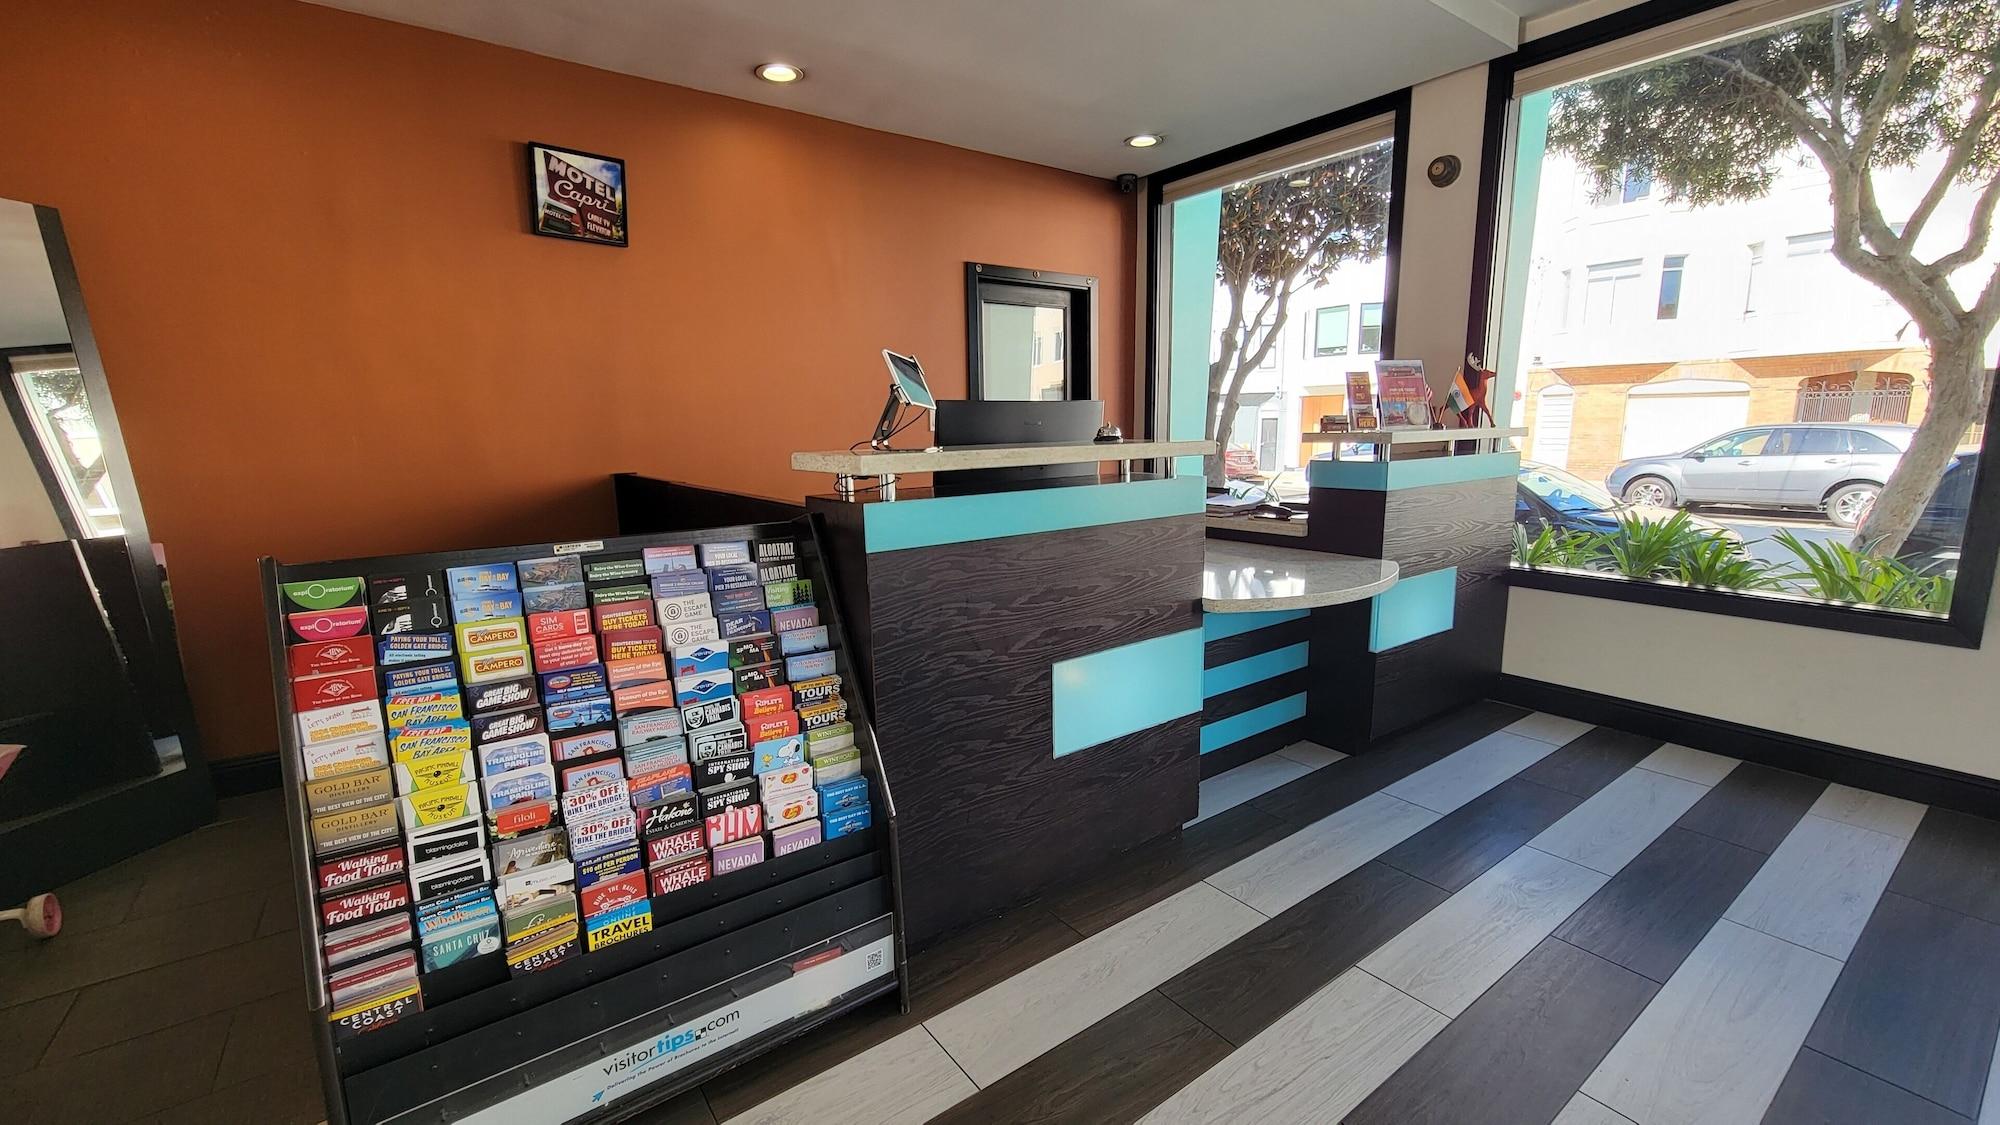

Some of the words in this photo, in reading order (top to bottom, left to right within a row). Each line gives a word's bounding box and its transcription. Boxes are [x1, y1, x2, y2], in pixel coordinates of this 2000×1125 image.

[548, 155, 615, 202] MOTEL
[554, 180, 619, 215] Capri
[759, 542, 795, 557] ALCATRAZ
[761, 564, 797, 581] ALCATRAZ
[684, 603, 708, 612] ESCAPE
[540, 616, 558, 625] SIM
[602, 617, 619, 626] BUY
[619, 613, 648, 622] TICKETS
[623, 620, 649, 629] TODAY!
[780, 617, 813, 631] NEVADA
[535, 623, 564, 634] CARDS
[691, 628, 715, 637] ESCAPE
[470, 631, 517, 644] CAMPERO
[611, 646, 627, 654] BUY
[627, 643, 657, 652] TICKETS
[476, 659, 523, 672] CAMPERO
[613, 666, 635, 674] Museum
[393, 671, 414, 680] PAYING
[414, 669, 431, 677] YOUR
[393, 679, 416, 687] GOLDEN
[432, 672, 452, 680] BRIDGE
[396, 696, 418, 704] FREE
[418, 694, 435, 702] MAP
[476, 695, 502, 709] GAME
[501, 689, 529, 704] SHOW
[483, 689, 501, 698] GREAT
[501, 684, 520, 695] BIG
[618, 694, 641, 702] Museum
[799, 684, 840, 699] TOURS
[705, 704, 731, 715] CANNABIS
[754, 705, 778, 715] Believe
[755, 697, 782, 707] RIPLEY'S
[391, 710, 409, 720] SAN
[410, 703, 458, 716] FRANCISCO
[804, 709, 846, 726] TOURS
[482, 726, 508, 740] GAME
[507, 720, 535, 734] SHOW
[489, 720, 507, 730] GREAT
[507, 714, 525, 726] BIG
[405, 729, 425, 737] FREE
[425, 727, 445, 735] MAP
[400, 741, 417, 752] SAN
[420, 736, 467, 747] FRANCISCO
[568, 745, 580, 757] SAN
[579, 740, 612, 749] FRANCISCO
[718, 740, 743, 751] CANNABIS
[412, 749, 431, 760] BAY
[487, 749, 545, 765] TRAMPOLINE
[707, 757, 749, 767] INTERNATIONAL
[415, 764, 436, 776] PACIFIC
[504, 759, 529, 769] PARK
[707, 766, 725, 775] SPY
[725, 760, 750, 772] SHOP
[314, 782, 350, 796] GOLD
[353, 775, 380, 786] BAR
[572, 775, 583, 788] SAN
[583, 770, 616, 779] FRANCISCO
[491, 780, 550, 799] TRAMPOLINE
[509, 790, 534, 801] PARK
[569, 789, 598, 807] 30%
[599, 784, 620, 798] OFF
[707, 788, 749, 801] INTERNATIONAL
[327, 803, 341, 811] BEST
[567, 805, 584, 817] BIKE
[584, 801, 597, 811] THE
[707, 801, 724, 810] SPY
[725, 792, 750, 805] SHOP
[321, 816, 357, 830] GOLD
[361, 808, 387, 820] BAR
[513, 811, 536, 824] filoli
[645, 806, 694, 829] Hakone
[670, 818, 695, 828] GARDENS
[581, 822, 608, 836] 30%
[611, 816, 632, 828] OFF
[577, 835, 593, 845] BIKE
[594, 832, 607, 840] THE
[608, 825, 633, 837] BRIDGE
[652, 831, 700, 853] WHALE
[425, 840, 469, 854] bloomingdales
[656, 842, 697, 860] WATCH
[780, 836, 816, 855] NEVADA
[338, 854, 389, 872] Walking
[582, 866, 594, 875] $10
[594, 863, 603, 871] off
[603, 860, 615, 868] PER
[615, 853, 639, 864] PERSON
[718, 853, 758, 871] NEVADA
[325, 868, 361, 888] Food
[363, 860, 403, 877] Tours
[660, 866, 707, 886] WHALE
[431, 875, 474, 890] bloomingdales
[607, 884, 619, 894] THE
[622, 884, 638, 895] RAILS
[340, 890, 390, 909] Walking
[327, 906, 363, 925] Food
[366, 896, 405, 914] Tours
[592, 916, 649, 942] TRAVEL
[432, 938, 463, 957] SANTA
[467, 929, 490, 948] CRUZ
[594, 927, 649, 950] BROCHURES
[514, 942, 573, 969] CENTRAL
[524, 949, 567, 971] COAST
[340, 997, 413, 1026] CENTRAL
[352, 1006, 404, 1029] COAST
[606, 1074, 636, 1090] Delivering
[648, 1060, 666, 1071] Power
[674, 1047, 700, 1060] Brochures
